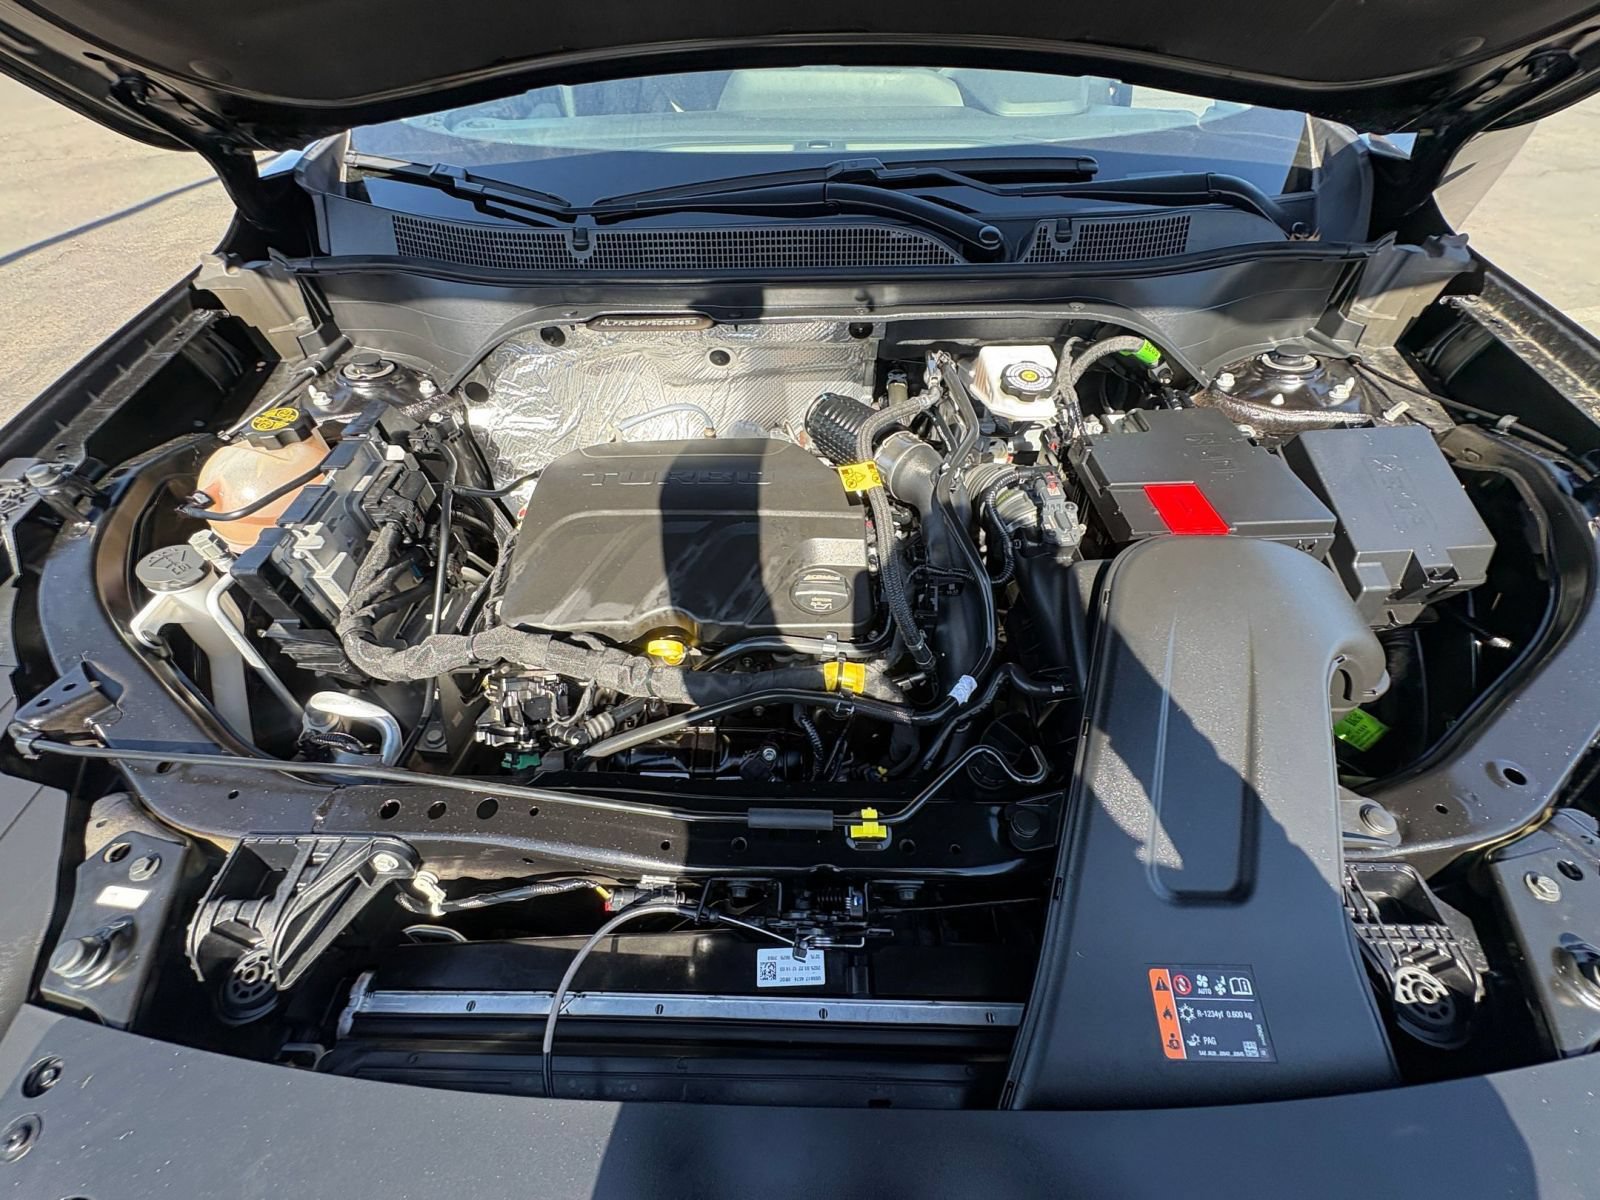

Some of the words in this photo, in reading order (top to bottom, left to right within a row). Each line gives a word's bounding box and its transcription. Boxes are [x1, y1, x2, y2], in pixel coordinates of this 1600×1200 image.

[582, 471, 773, 486] TURBO
[1244, 1011, 1253, 1020] kg
[1202, 1036, 1217, 1045] PAG
